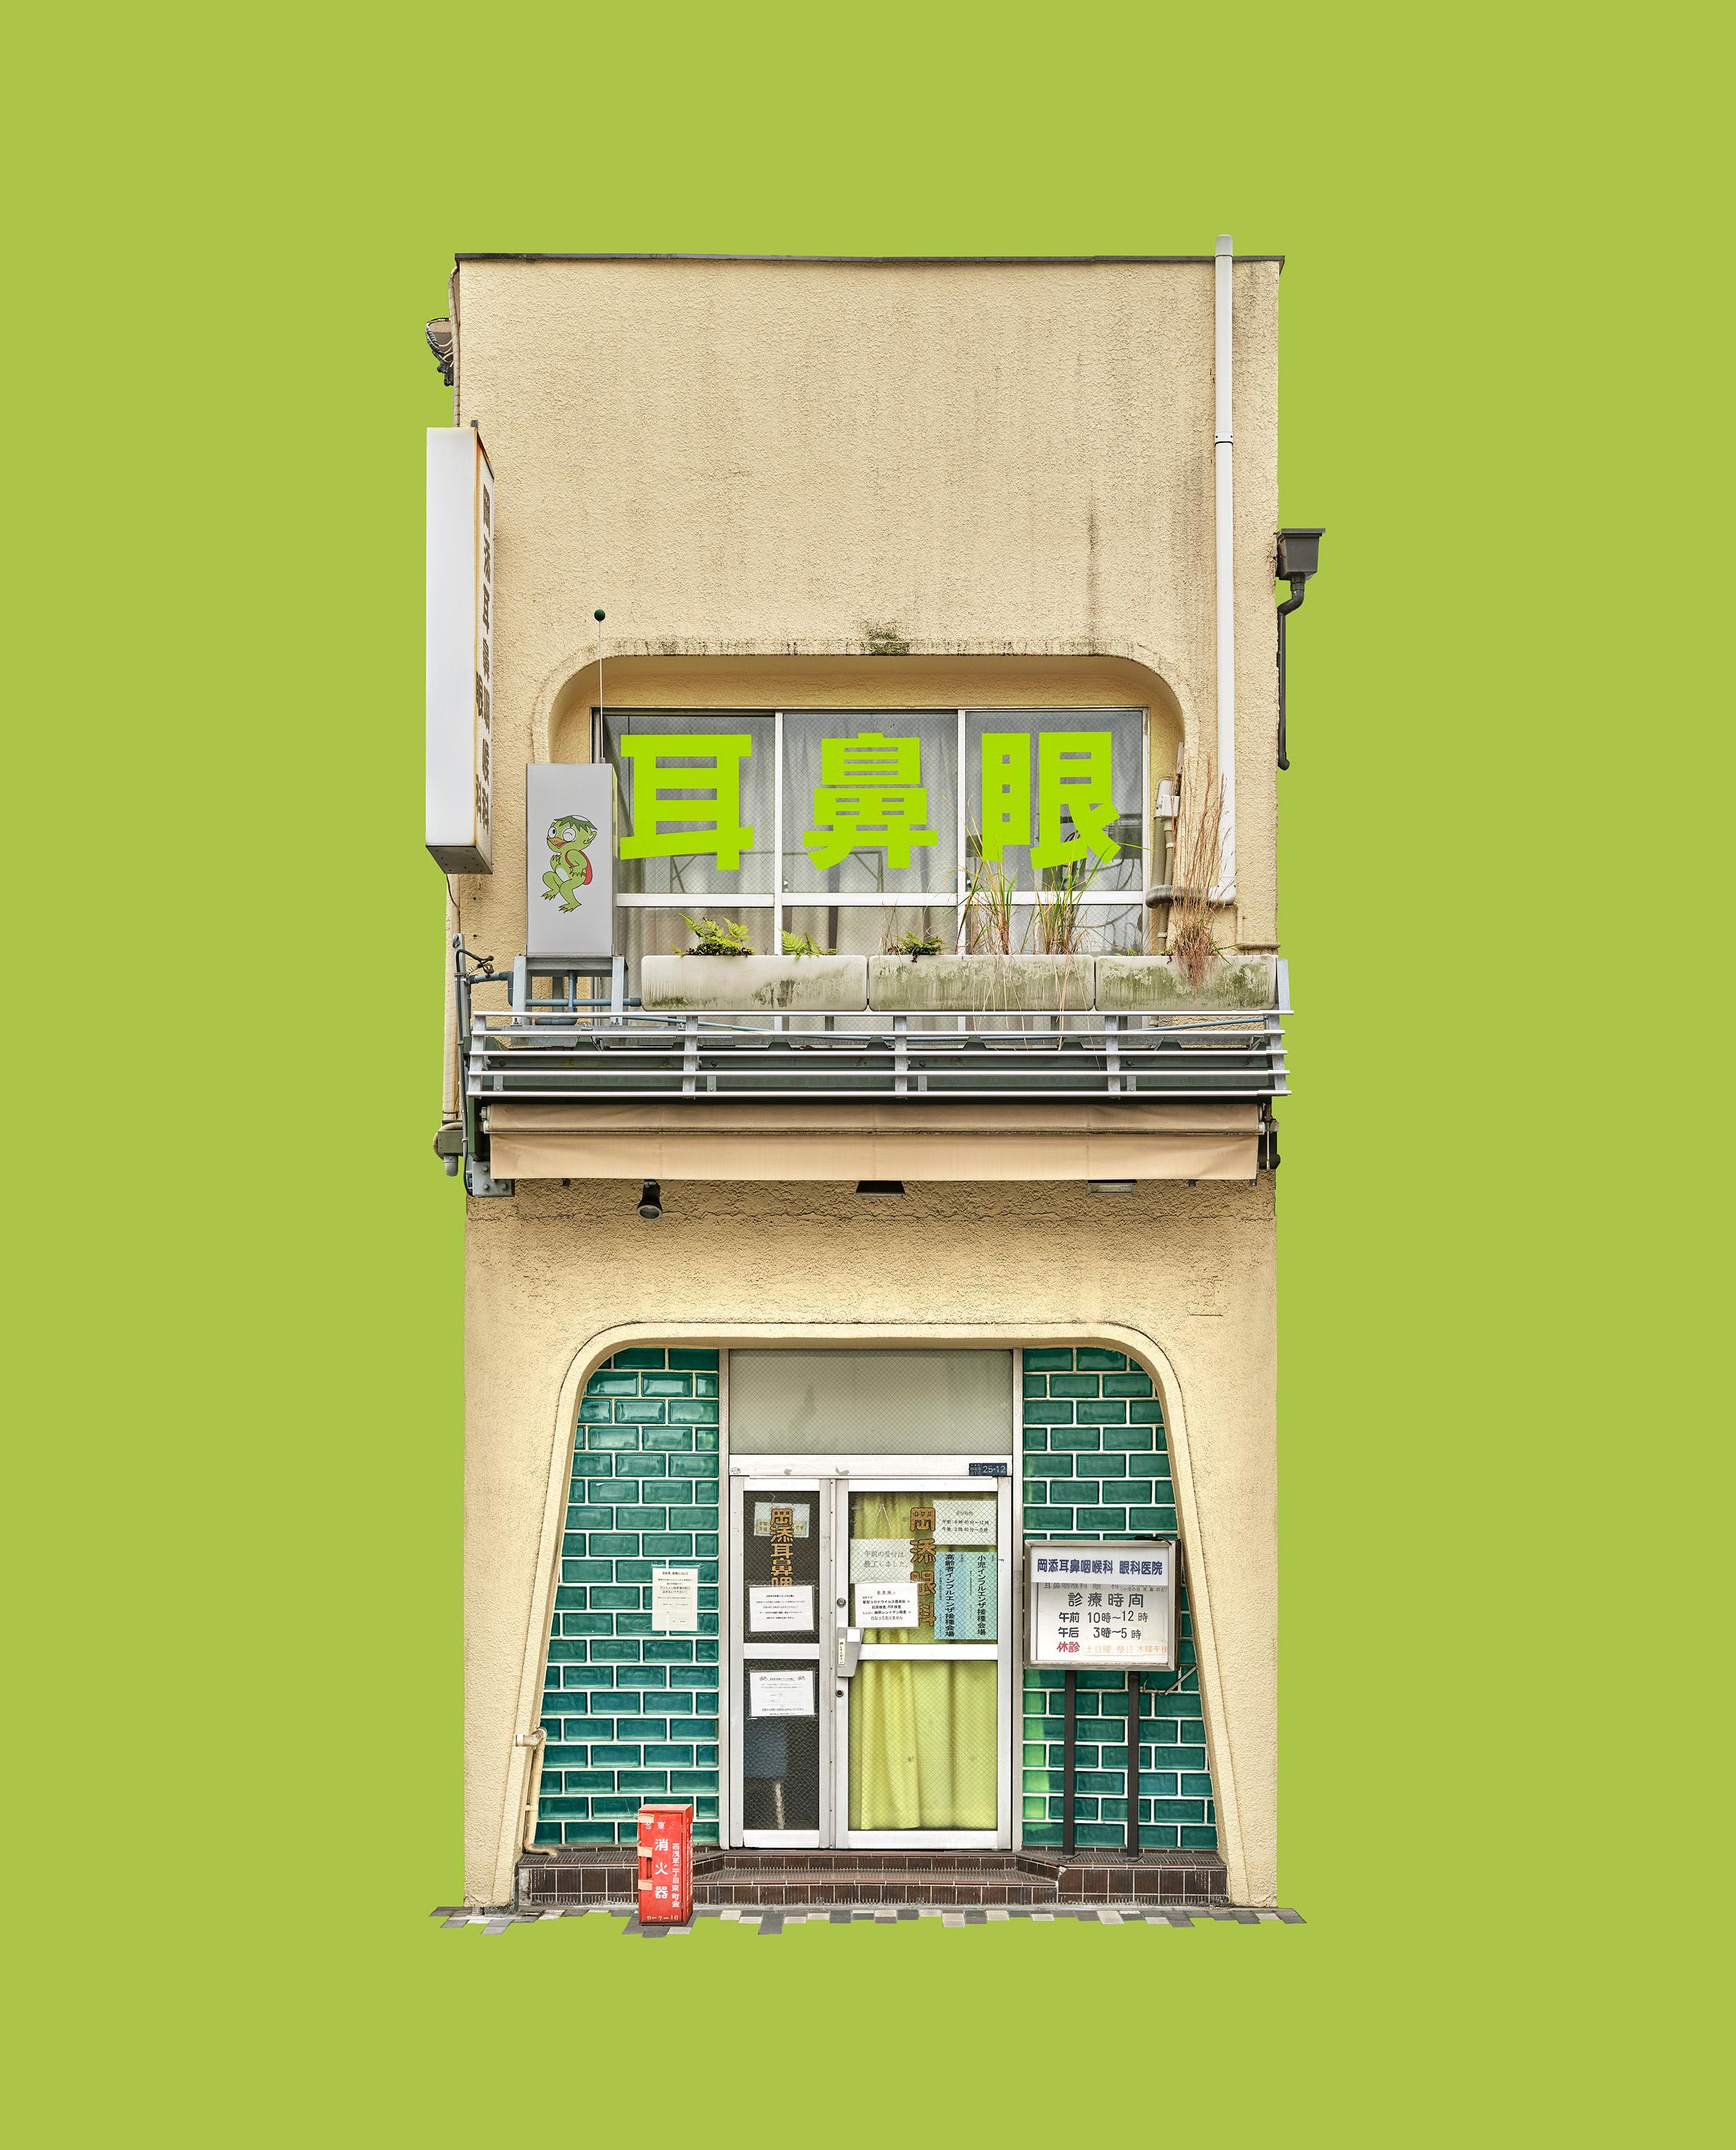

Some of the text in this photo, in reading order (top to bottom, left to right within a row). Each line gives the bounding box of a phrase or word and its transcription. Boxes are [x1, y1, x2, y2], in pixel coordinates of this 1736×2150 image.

[620, 732, 1121, 870] 耳鼻眼
[1037, 1559, 1163, 1575] 岡添耳鼻咽喉科 眼科医院
[945, 1554, 955, 1637] 高齢者インフルエンザ接種会場
[977, 1554, 987, 1635] 小児インフルエンザ接種会場
[1058, 1627, 1080, 1638] 午后
[1059, 1612, 1080, 1623] 午前
[1057, 1641, 1080, 1653] 休診
[654, 1838, 668, 1899] 消火器
